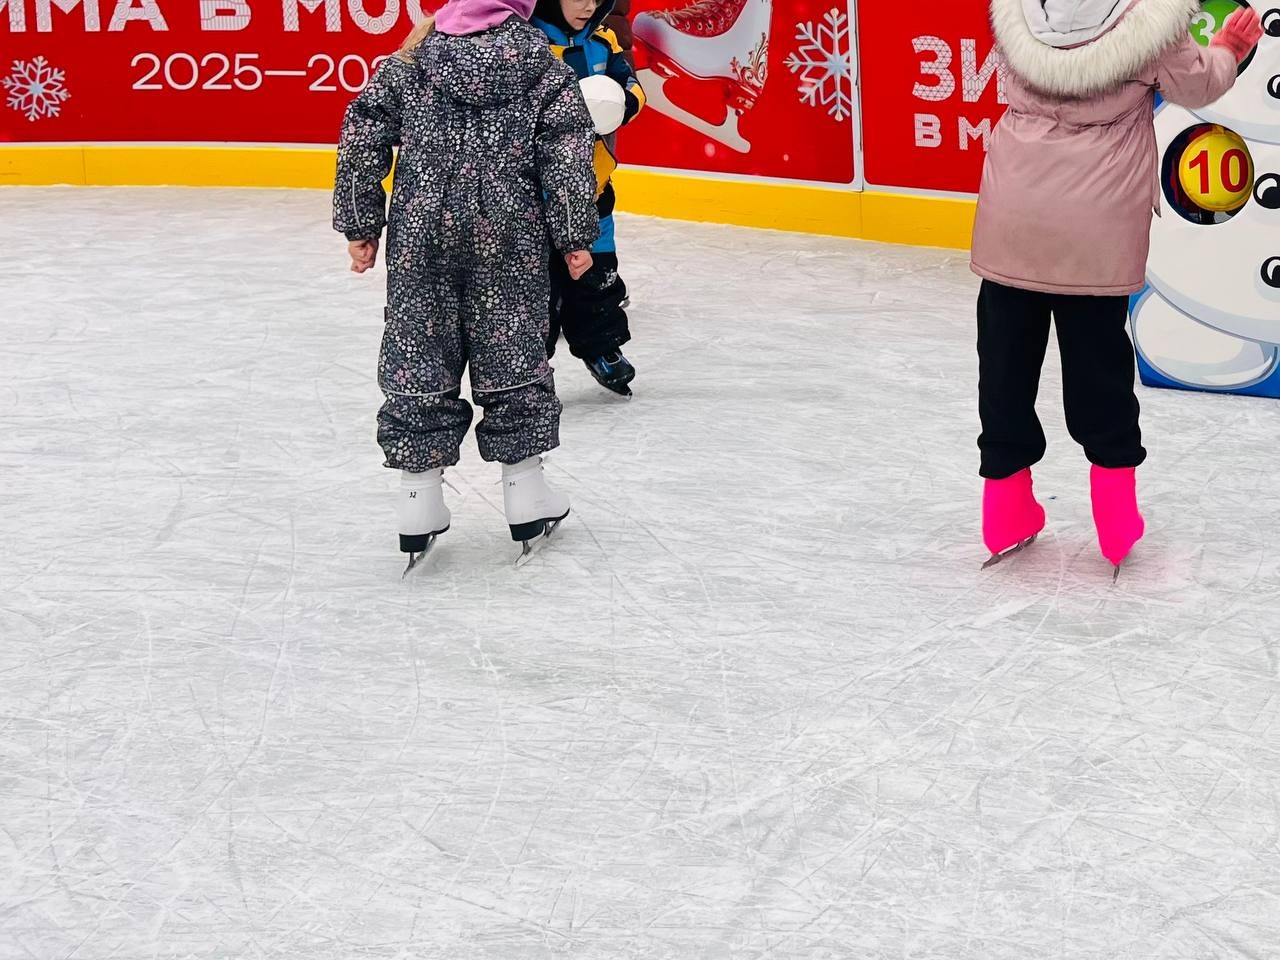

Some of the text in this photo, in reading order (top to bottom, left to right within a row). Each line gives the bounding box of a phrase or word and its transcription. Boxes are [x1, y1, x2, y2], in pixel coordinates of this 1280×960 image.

[1191, 11, 1233, 42] 3
[914, 113, 942, 148] В
[1189, 149, 1249, 195] 10
